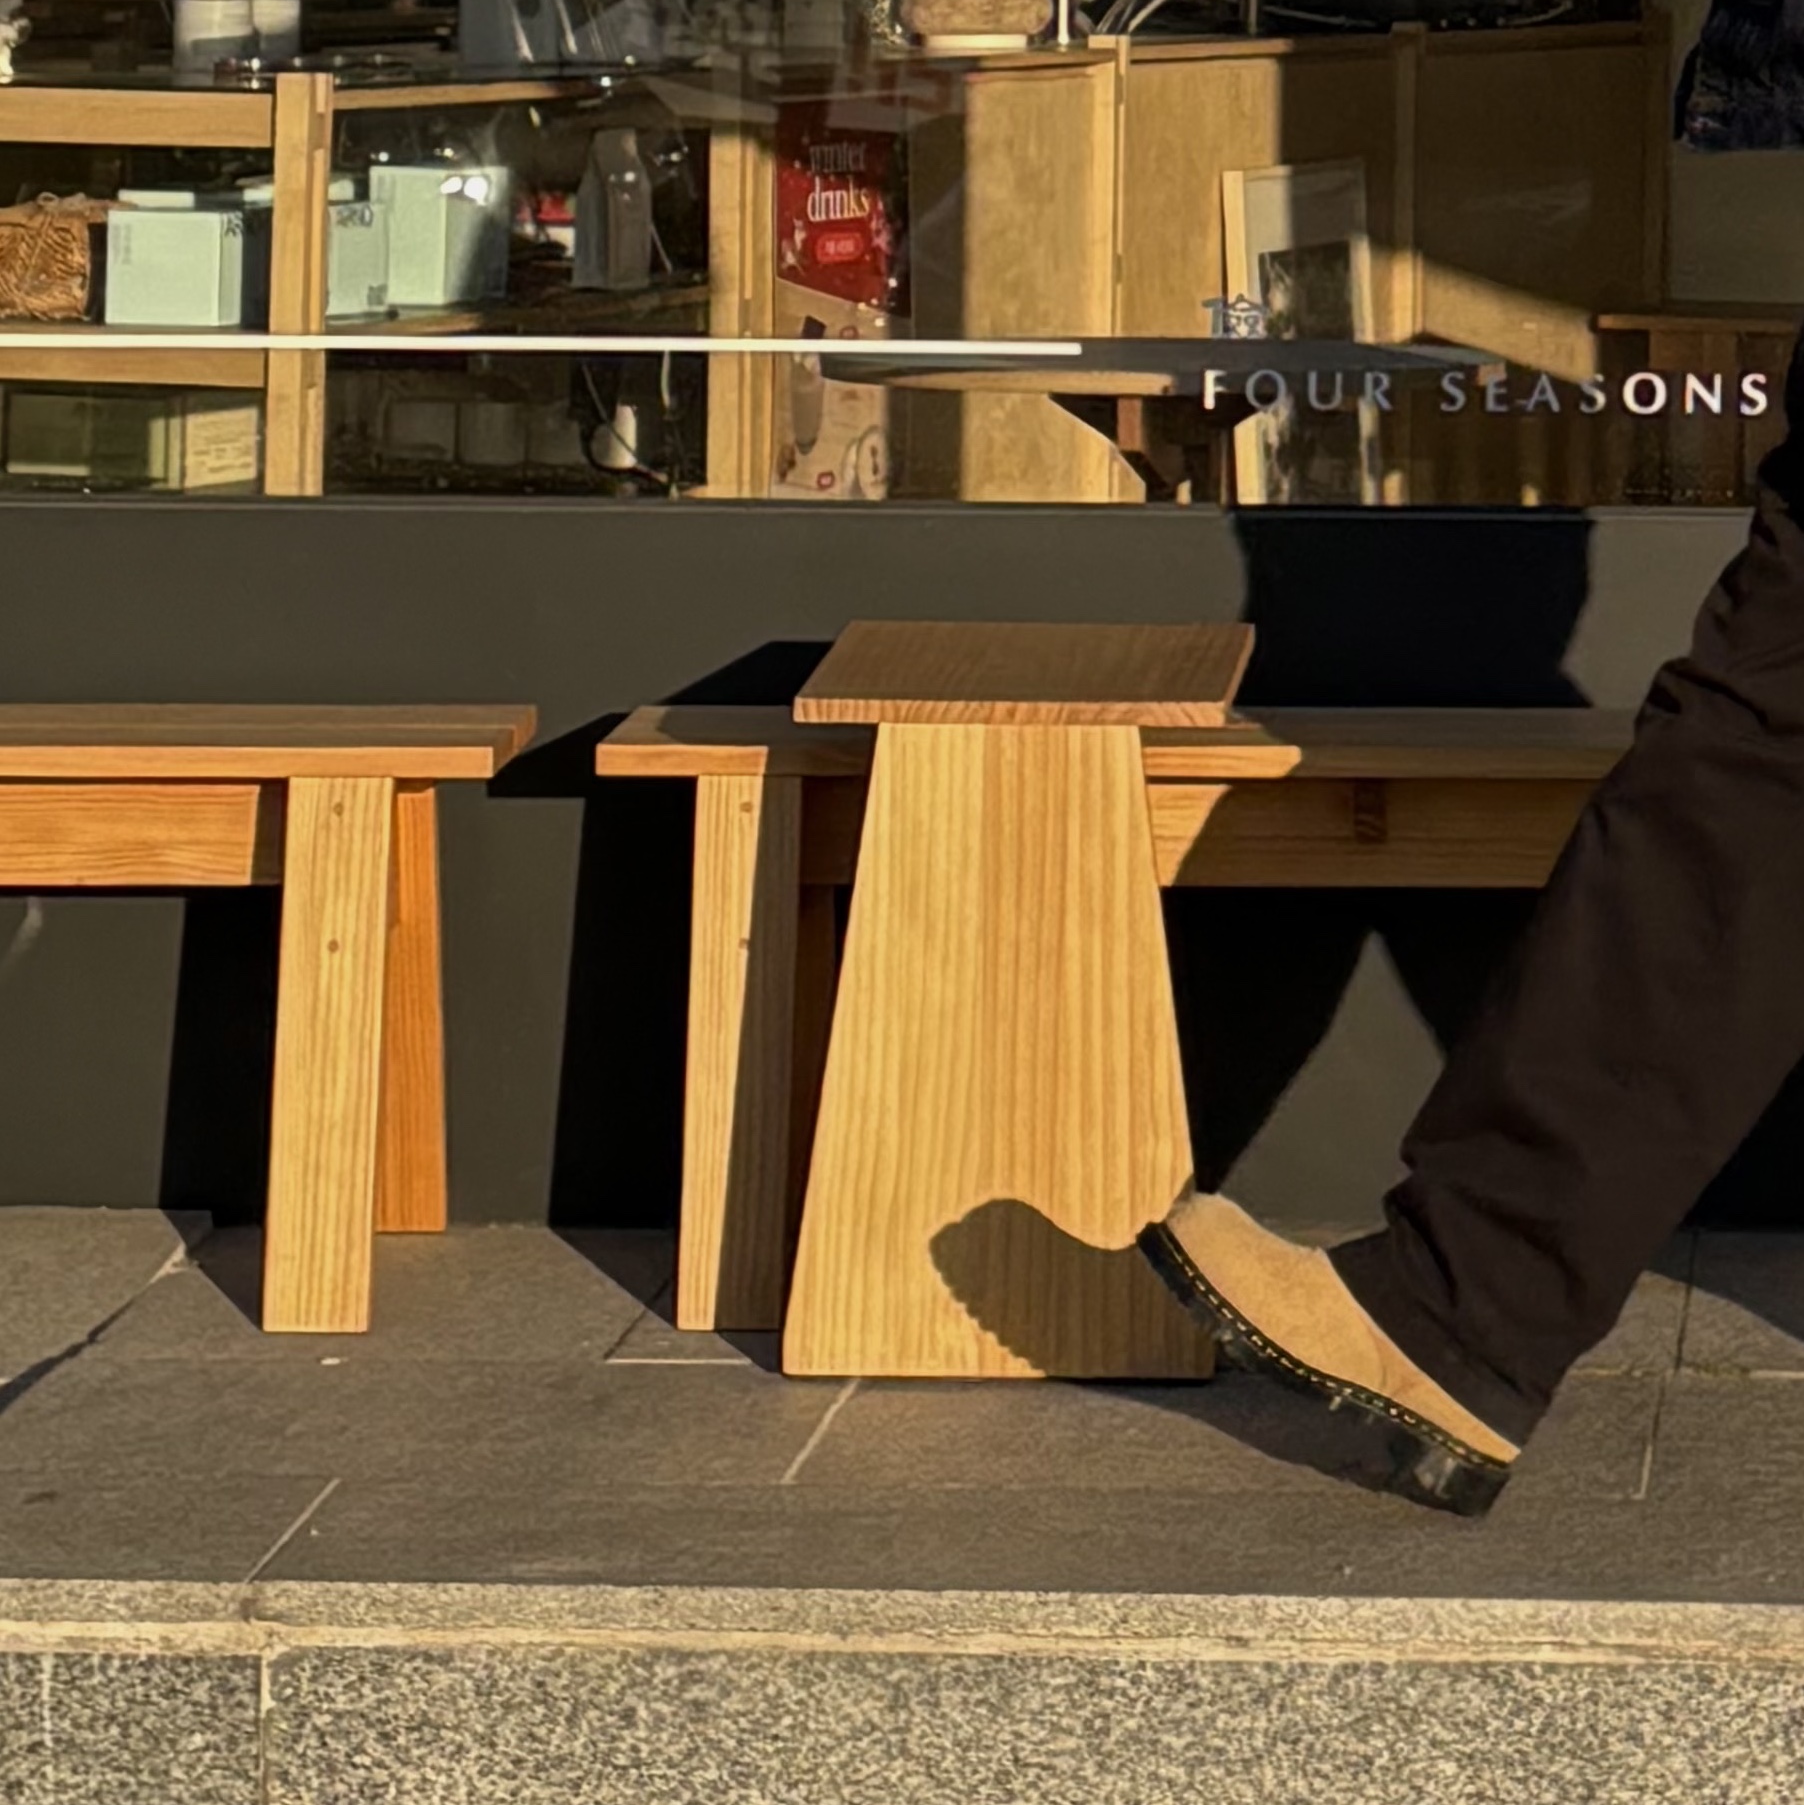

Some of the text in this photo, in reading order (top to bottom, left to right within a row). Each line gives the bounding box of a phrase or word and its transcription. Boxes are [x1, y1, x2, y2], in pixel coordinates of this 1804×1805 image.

[806, 175, 870, 222] drinks
[1203, 368, 1769, 416] FOUR SEASONS
